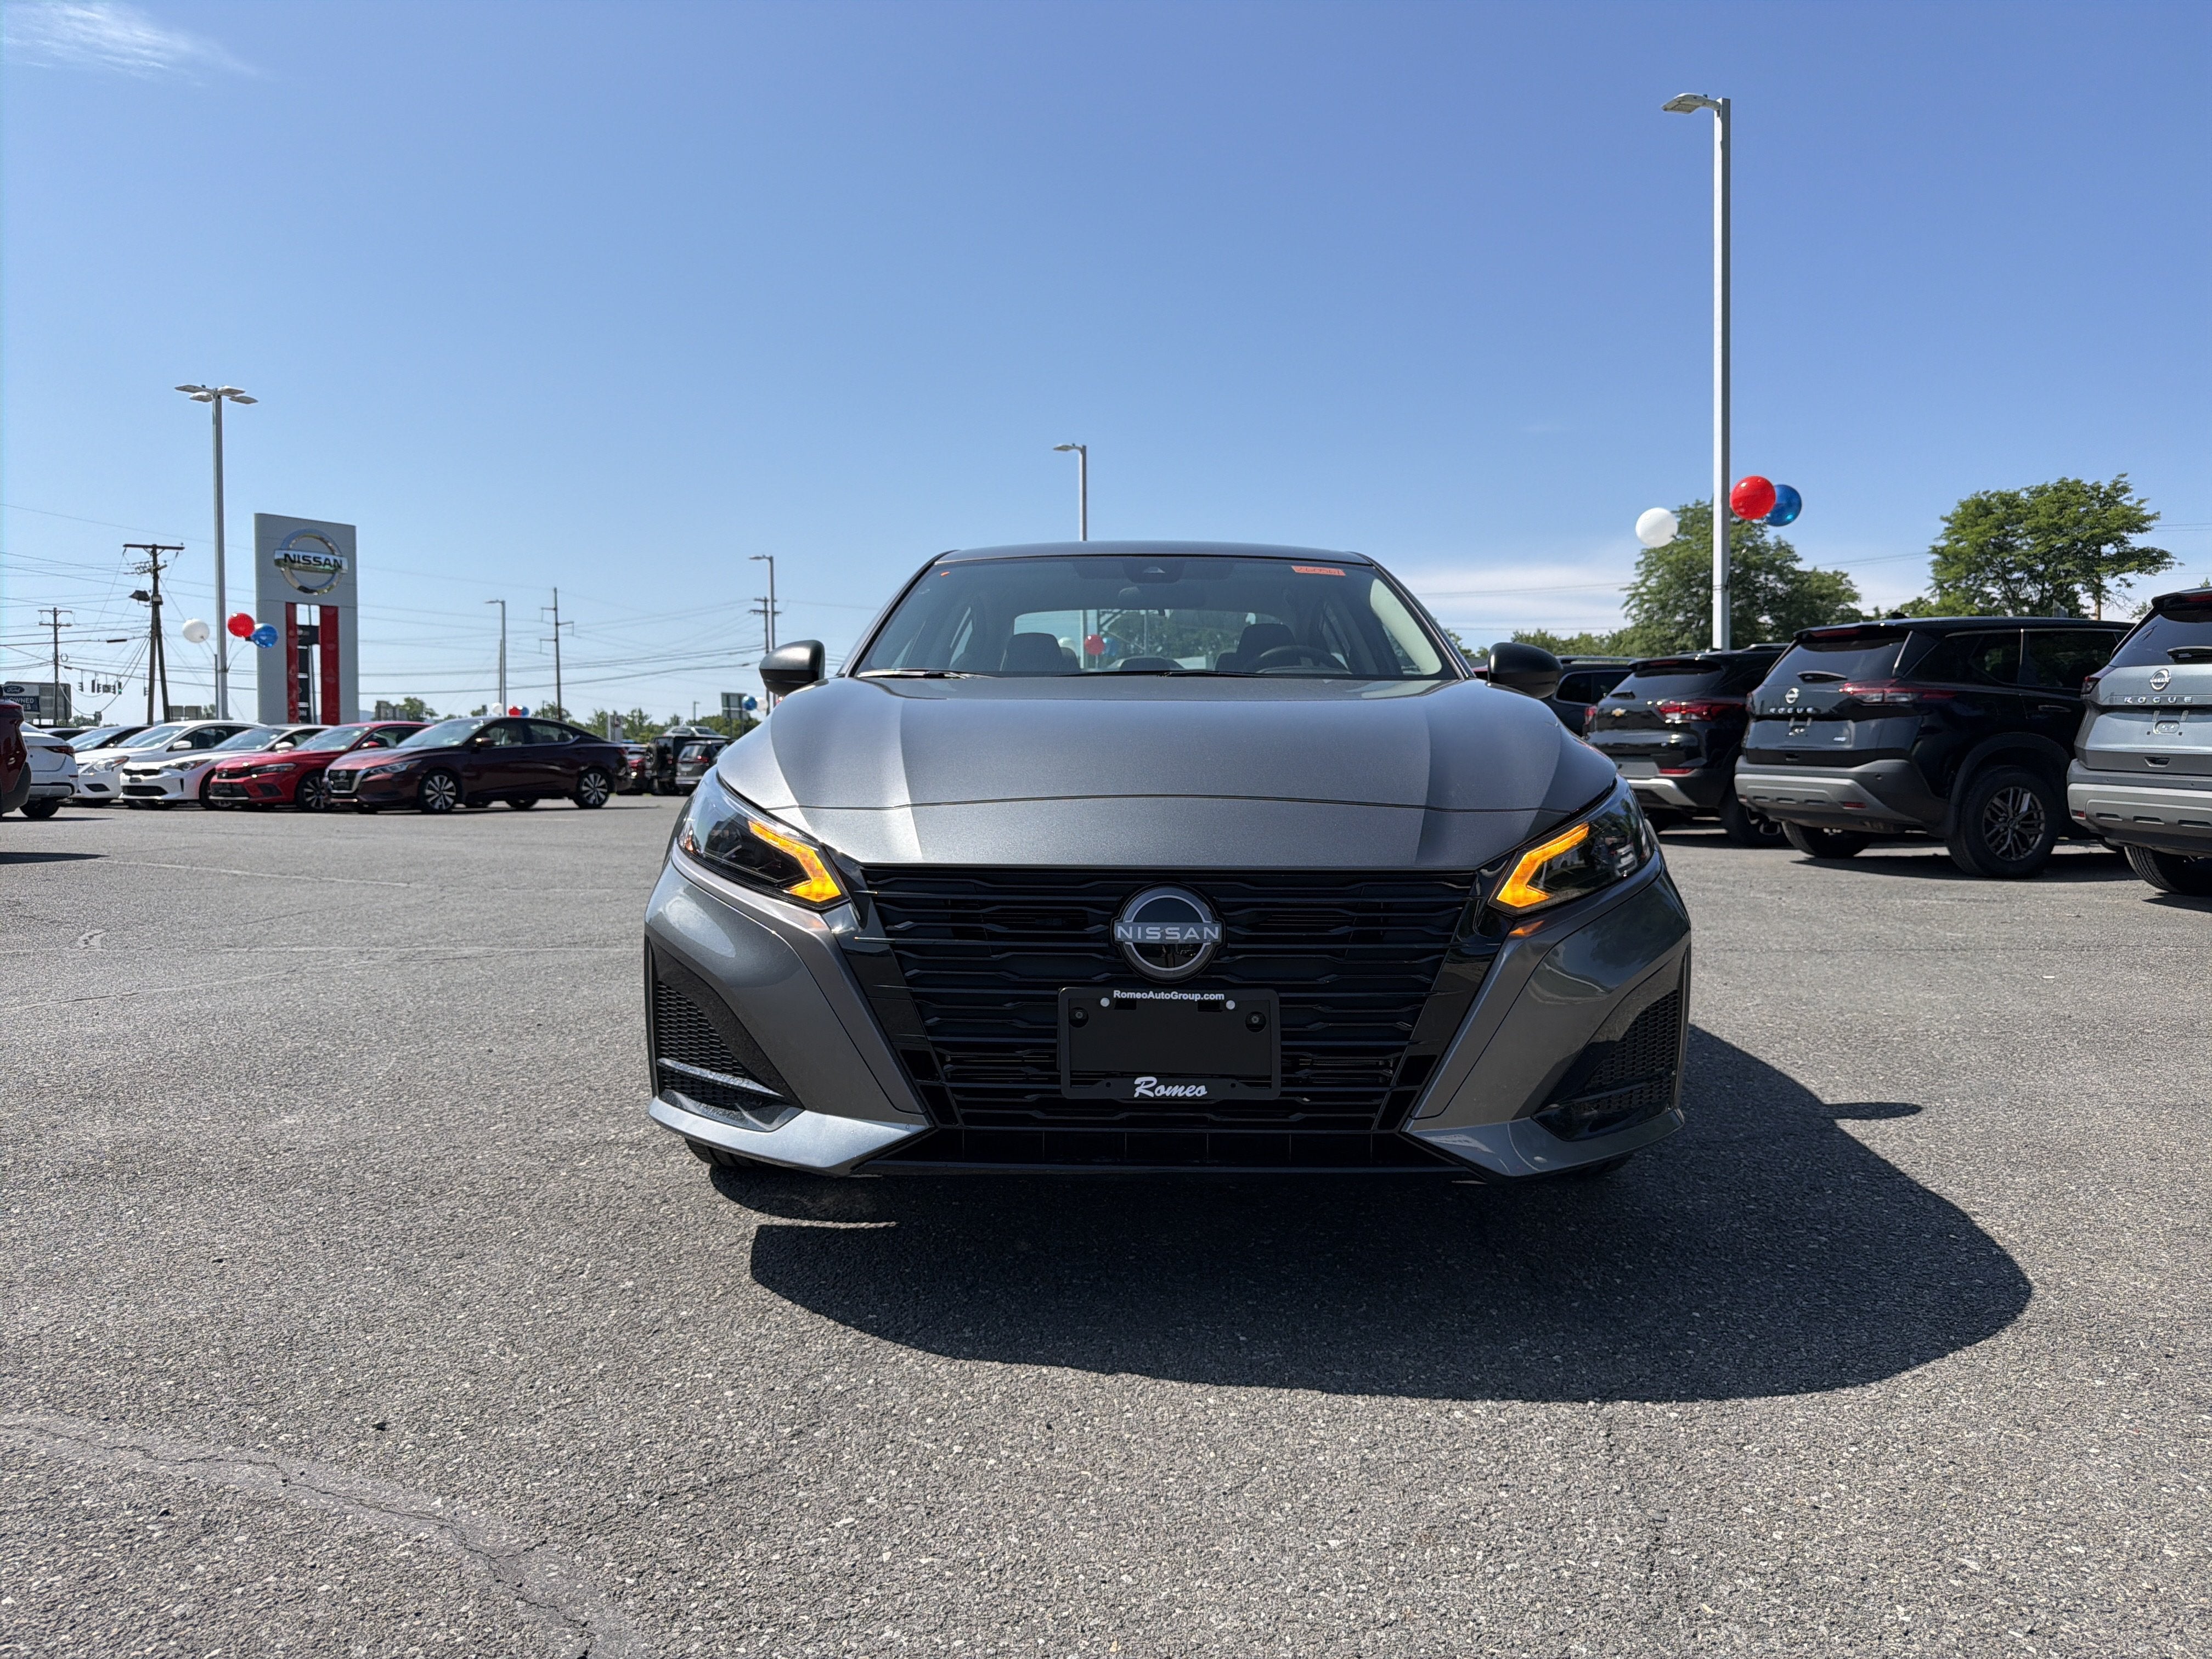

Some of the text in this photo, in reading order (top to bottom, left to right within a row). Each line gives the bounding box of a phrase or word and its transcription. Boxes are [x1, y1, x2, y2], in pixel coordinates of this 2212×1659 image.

[284, 554, 343, 569] NISSAN
[1117, 926, 1219, 940] NISSAN
[1113, 990, 1225, 1002] RomeoAutoGroup.com
[1133, 1076, 1207, 1098] Romeo
